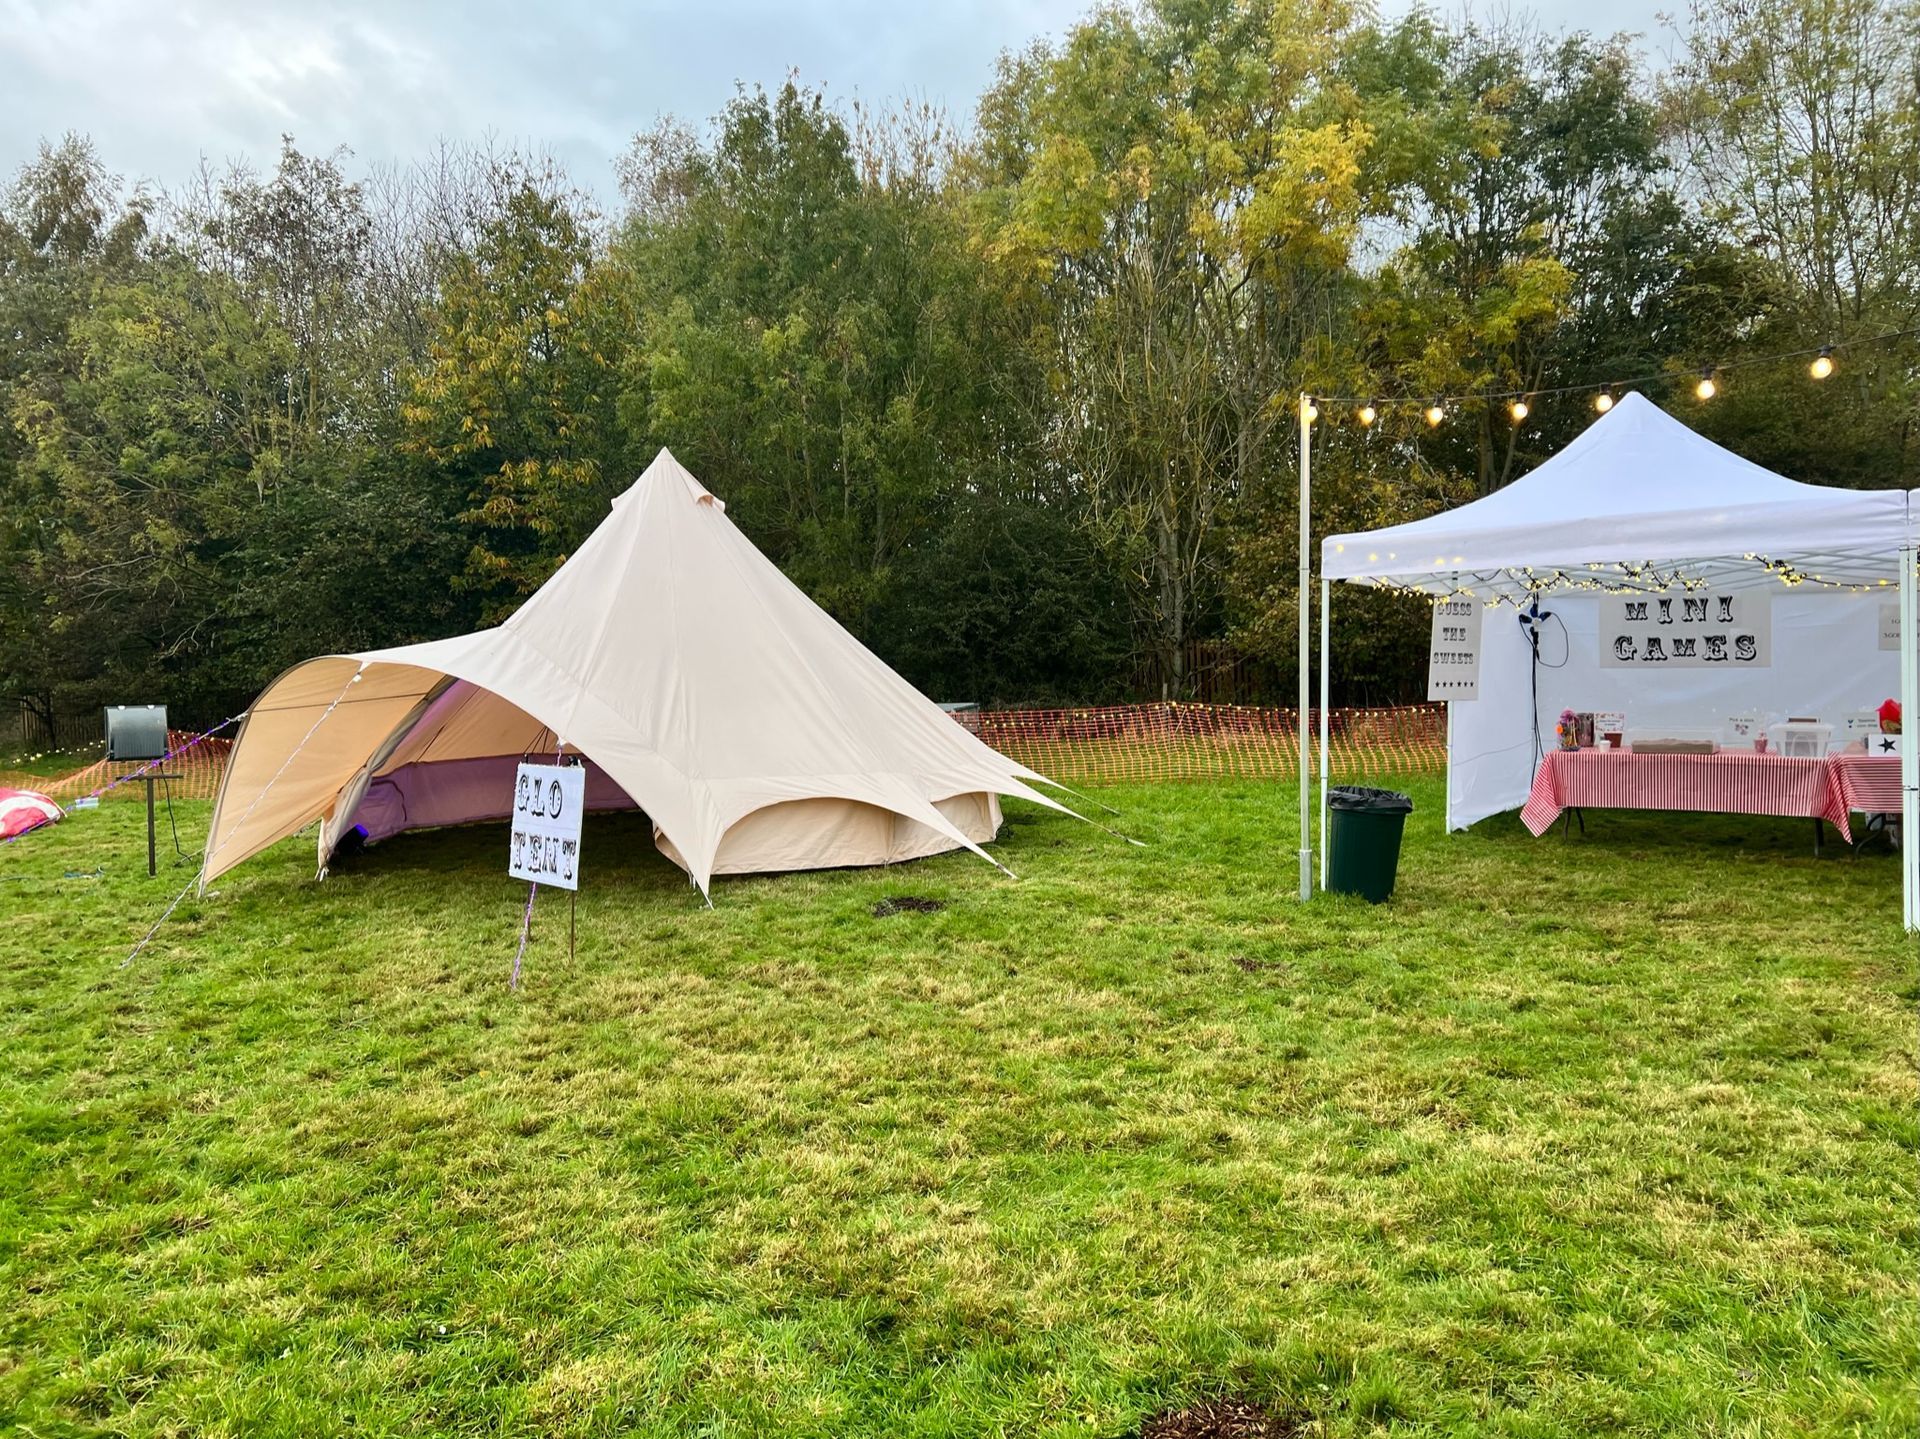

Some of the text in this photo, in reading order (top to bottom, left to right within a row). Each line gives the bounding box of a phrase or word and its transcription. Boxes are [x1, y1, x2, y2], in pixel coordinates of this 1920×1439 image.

[1436, 601, 1473, 617] GUESS
[1625, 595, 1733, 625] MINI
[1442, 626, 1467, 642] THE
[1613, 634, 1757, 662] GAMES
[1433, 651, 1474, 665] SWEETS
[516, 773, 563, 819] GLO
[512, 831, 577, 881] TENT
